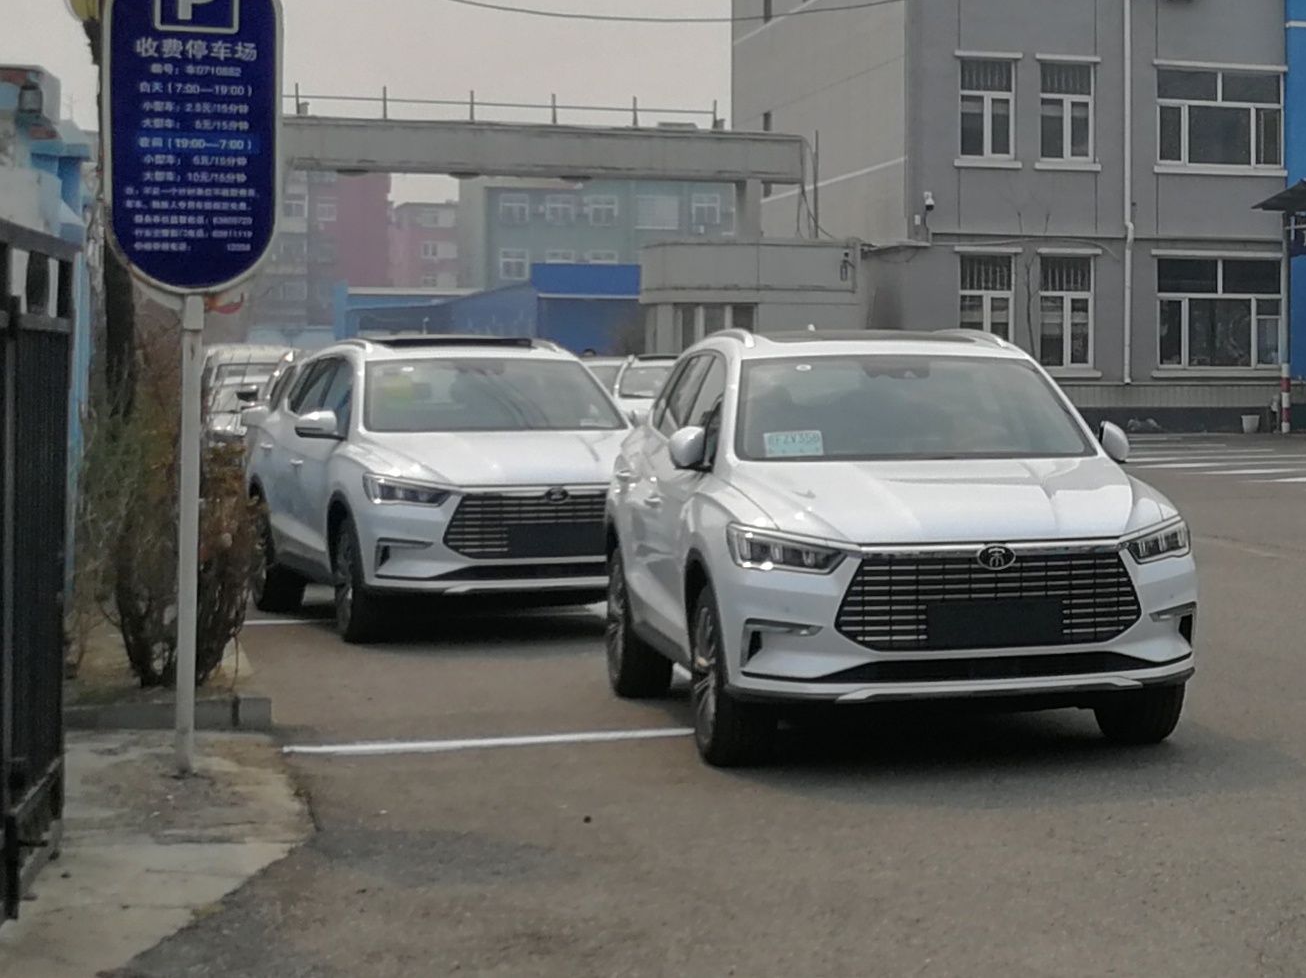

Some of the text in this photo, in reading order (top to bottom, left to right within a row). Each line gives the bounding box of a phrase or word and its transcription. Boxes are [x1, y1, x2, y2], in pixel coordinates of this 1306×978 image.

[136, 37, 258, 62] 收费停车场
